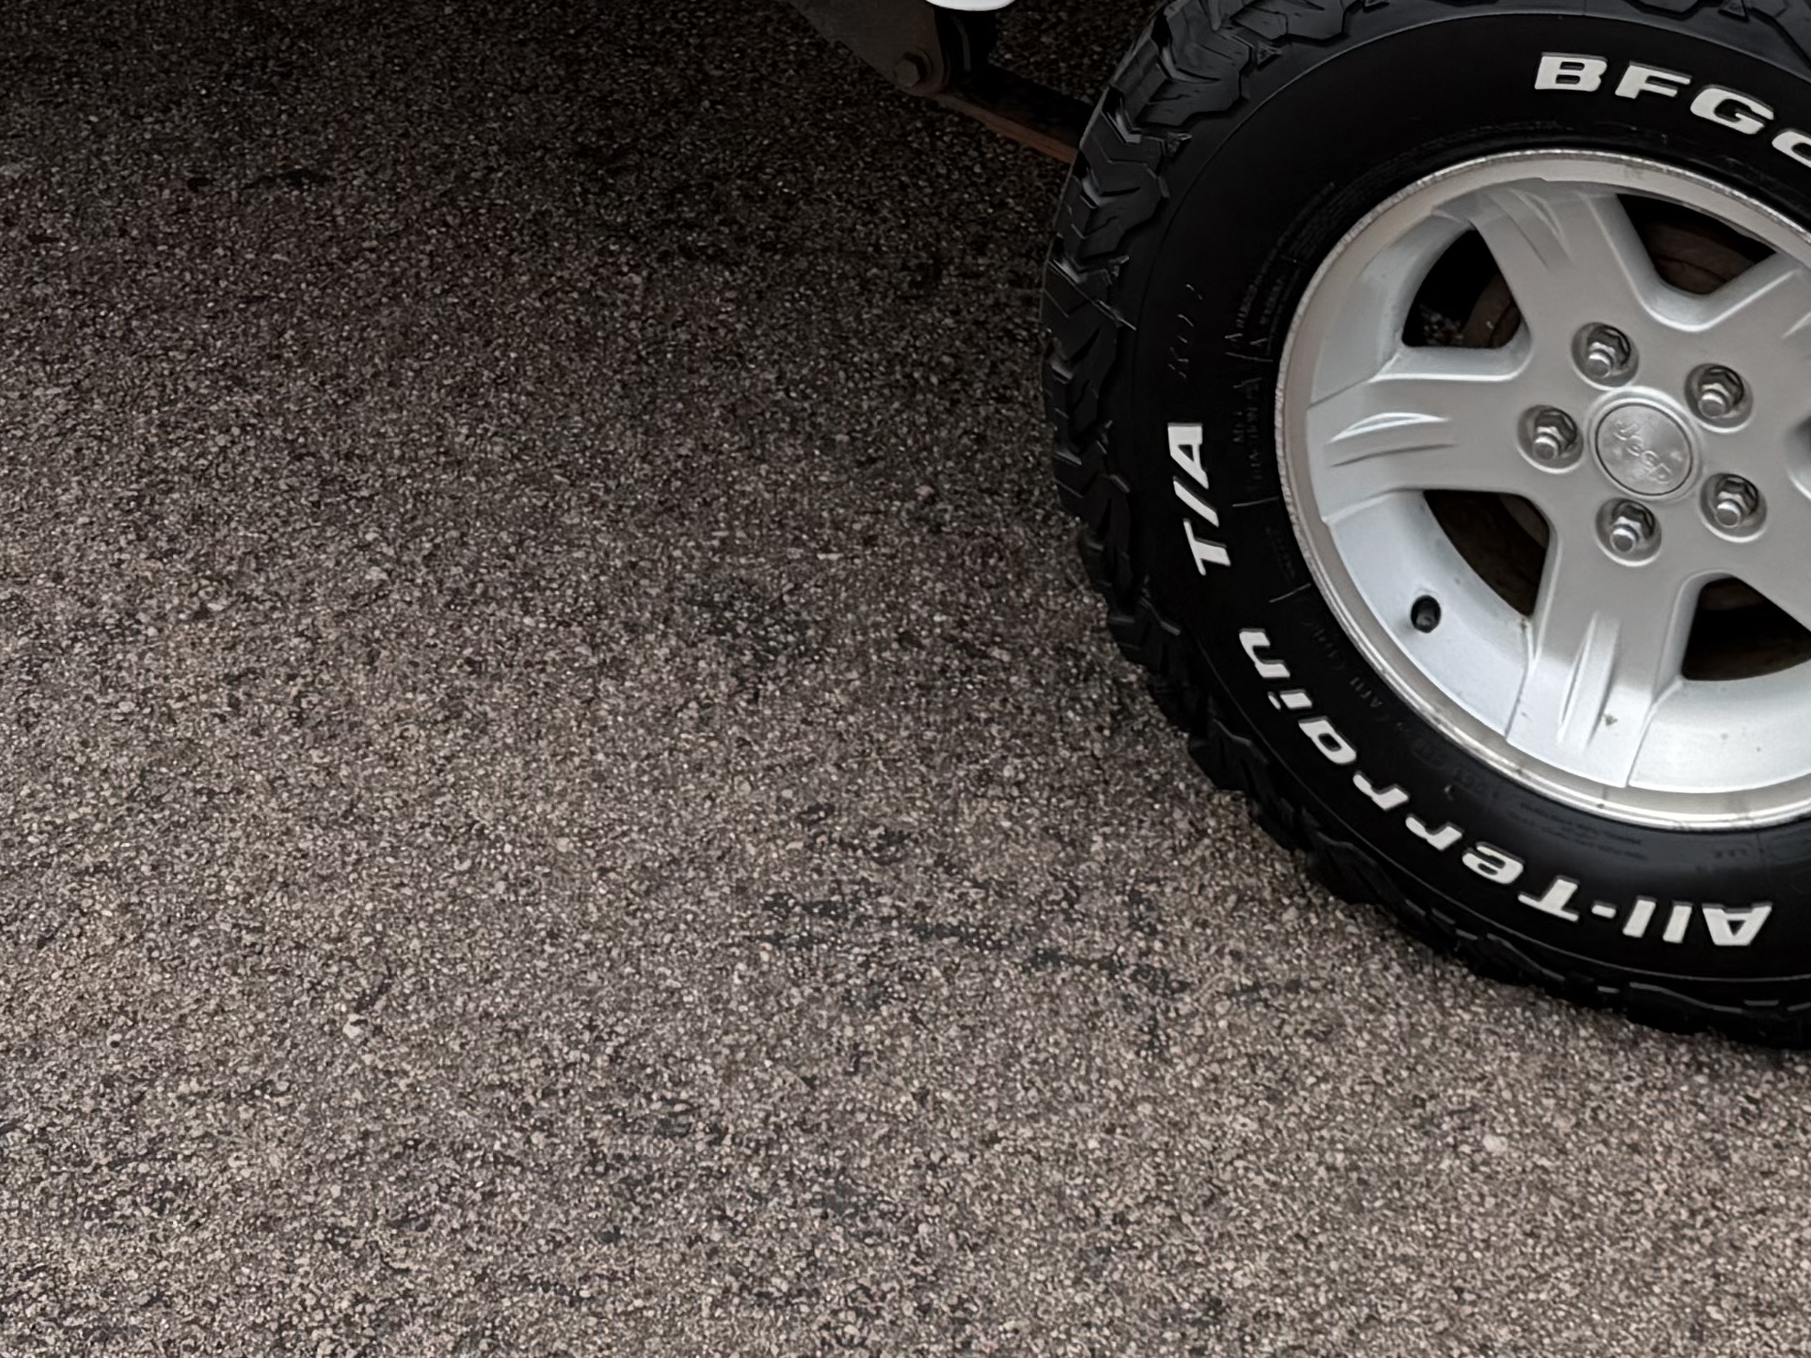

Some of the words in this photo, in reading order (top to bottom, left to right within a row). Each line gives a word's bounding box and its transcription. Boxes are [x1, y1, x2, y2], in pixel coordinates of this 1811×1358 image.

[1166, 424, 1232, 577] T/A
[1612, 417, 1672, 484] Jeep
[1238, 629, 1773, 947] All-Terrain
